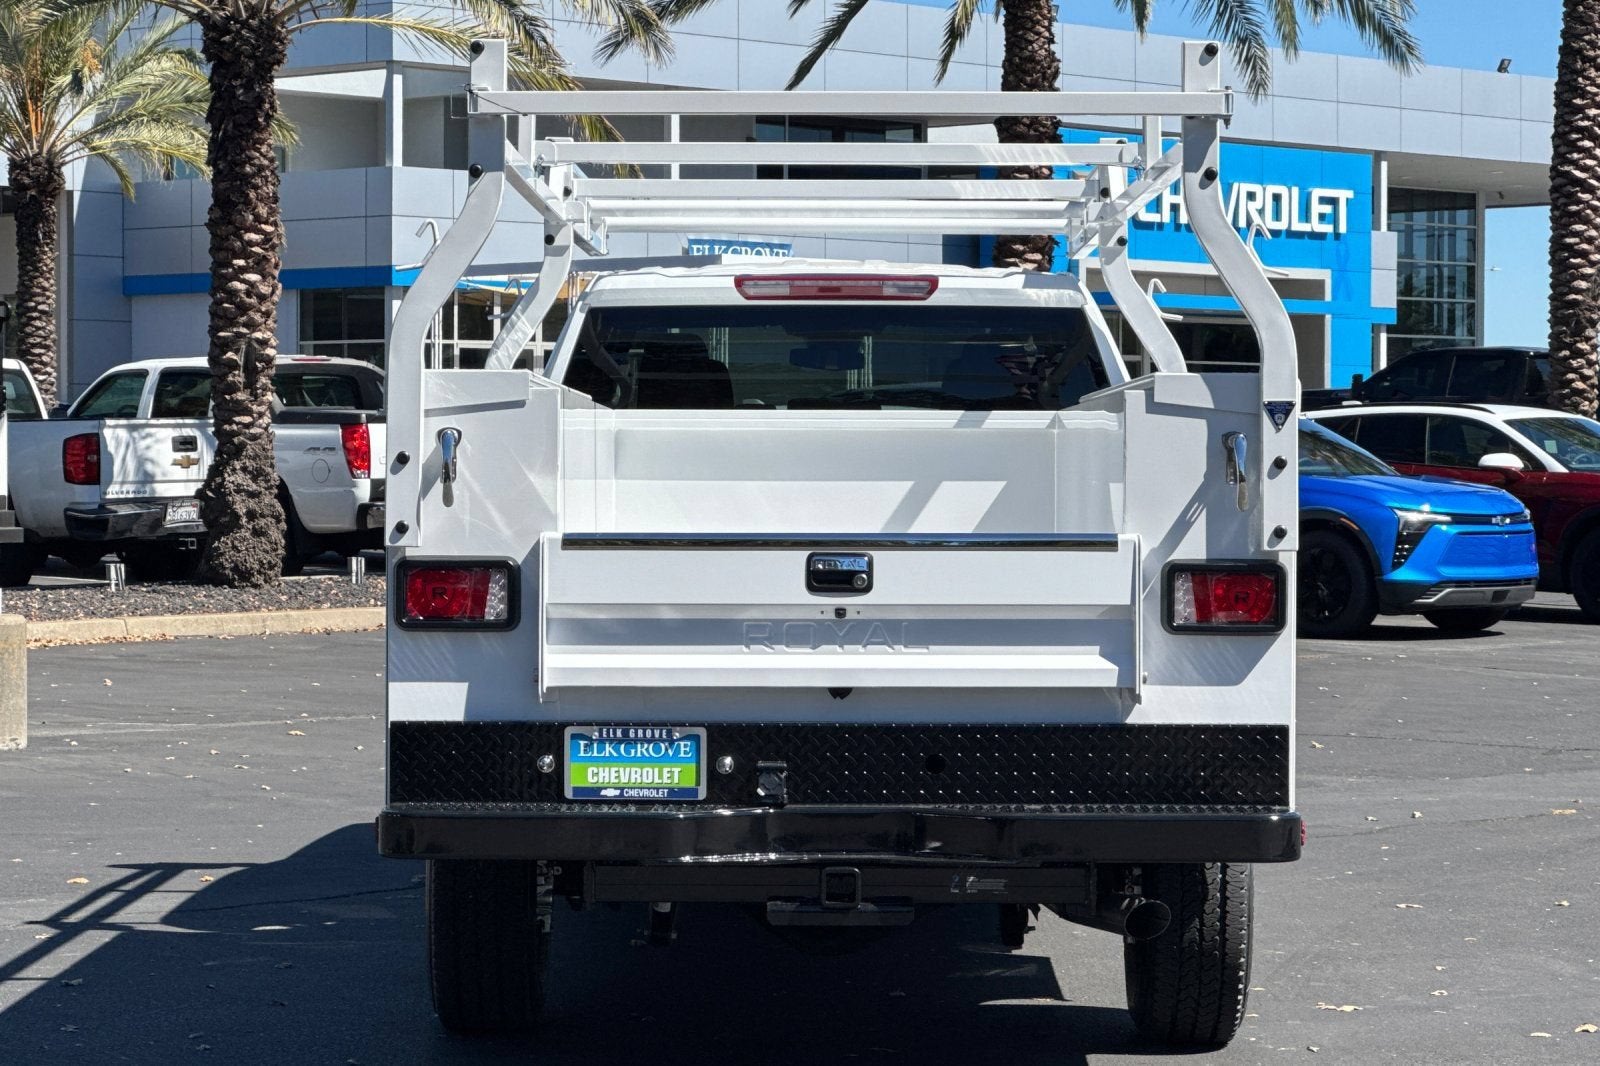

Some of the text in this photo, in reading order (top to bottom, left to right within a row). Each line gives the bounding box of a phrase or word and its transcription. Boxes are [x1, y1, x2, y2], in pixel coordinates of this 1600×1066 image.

[814, 558, 865, 569] ROYAL
[742, 621, 930, 653] ROYAL
[602, 728, 668, 739] ELK GROVE
[587, 766, 682, 785] CHEVROLET
[623, 788, 669, 798] CHEVROLET
